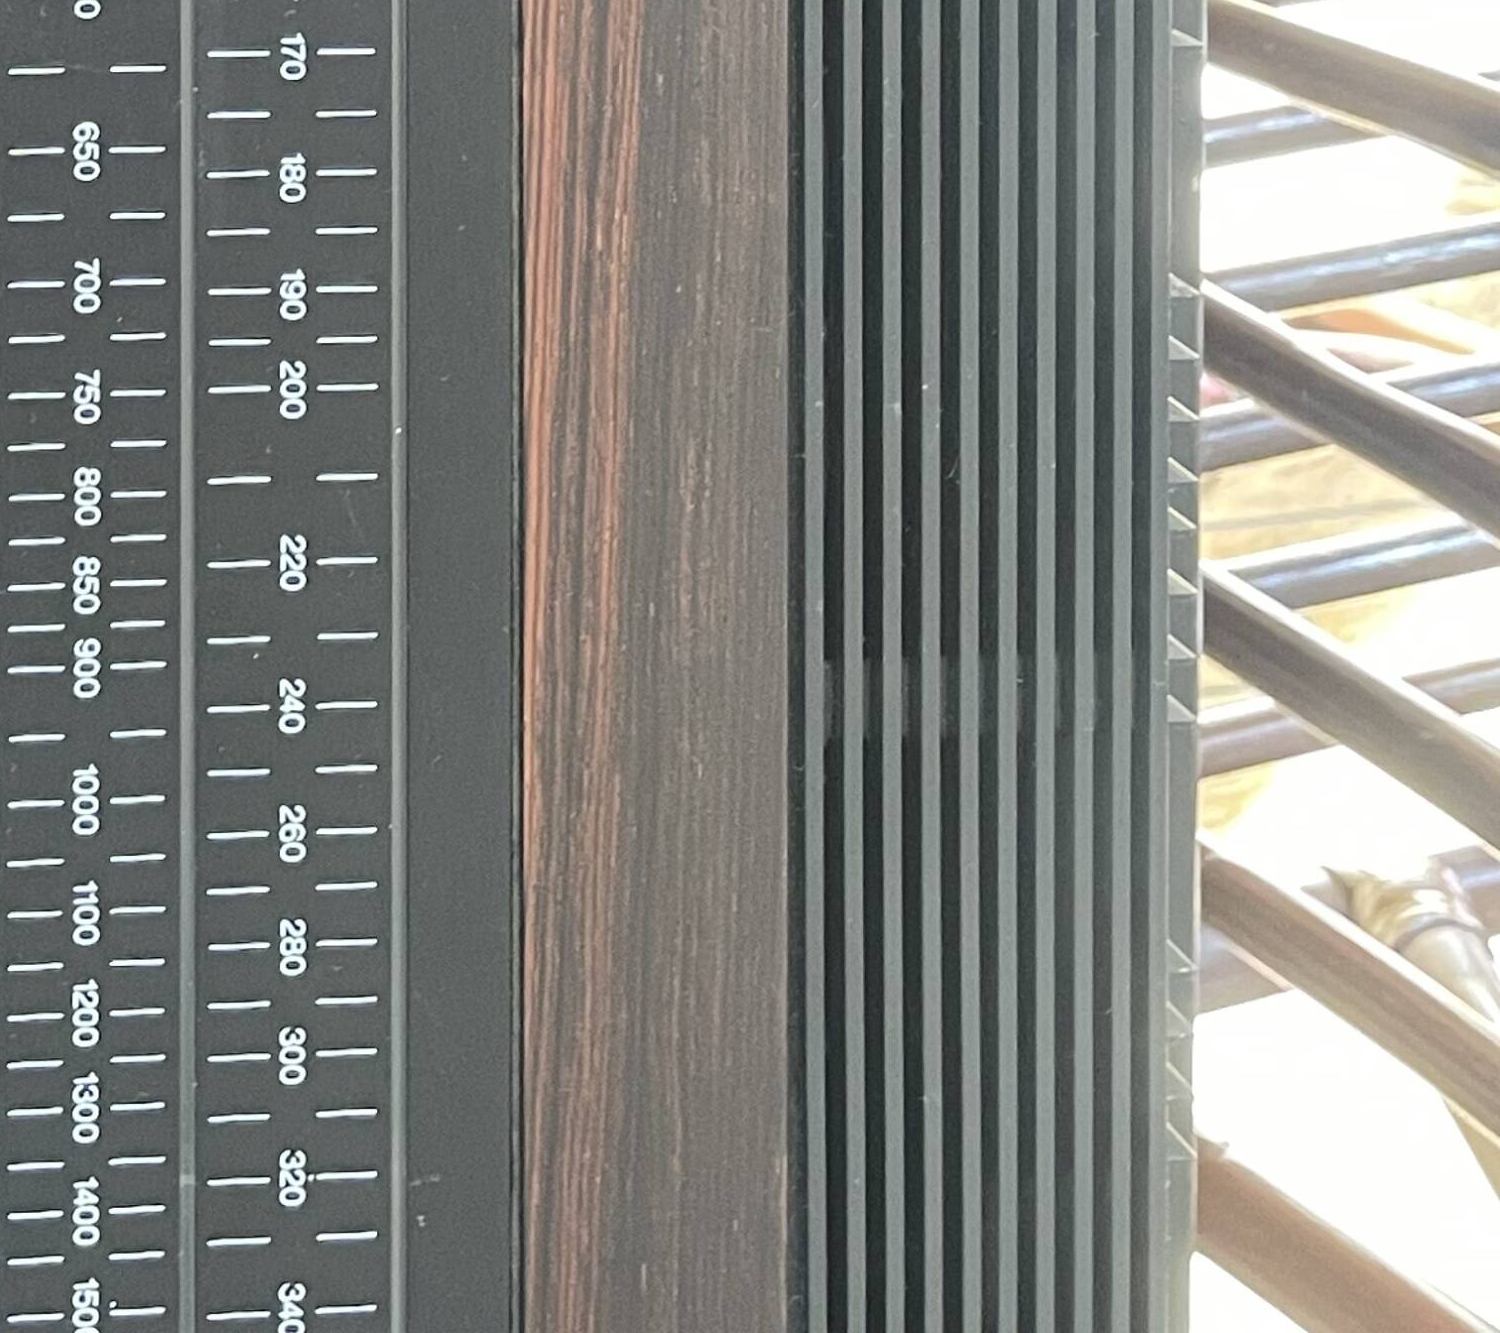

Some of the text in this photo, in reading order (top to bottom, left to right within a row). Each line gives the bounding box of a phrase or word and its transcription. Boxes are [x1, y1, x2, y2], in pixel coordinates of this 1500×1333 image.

[279, 32, 307, 81] 170
[72, 121, 101, 182] 650
[279, 152, 307, 203] 180
[73, 257, 101, 314] 700
[279, 268, 307, 321] 190
[73, 369, 101, 425] 750
[279, 360, 307, 420] 200
[73, 466, 102, 527] 800
[72, 556, 101, 615] 850
[279, 534, 307, 592] 220
[73, 637, 101, 699] 900
[278, 678, 307, 734] 240
[72, 763, 100, 836] 1000
[278, 804, 307, 863] 260
[72, 880, 101, 946] 1100
[279, 918, 307, 977] 280
[71, 978, 100, 1048] 1200
[278, 1026, 307, 1086] 300
[71, 1071, 100, 1144] 1300
[278, 1149, 307, 1207] 320
[72, 1176, 100, 1247] 1400
[71, 1277, 100, 1333] 150
